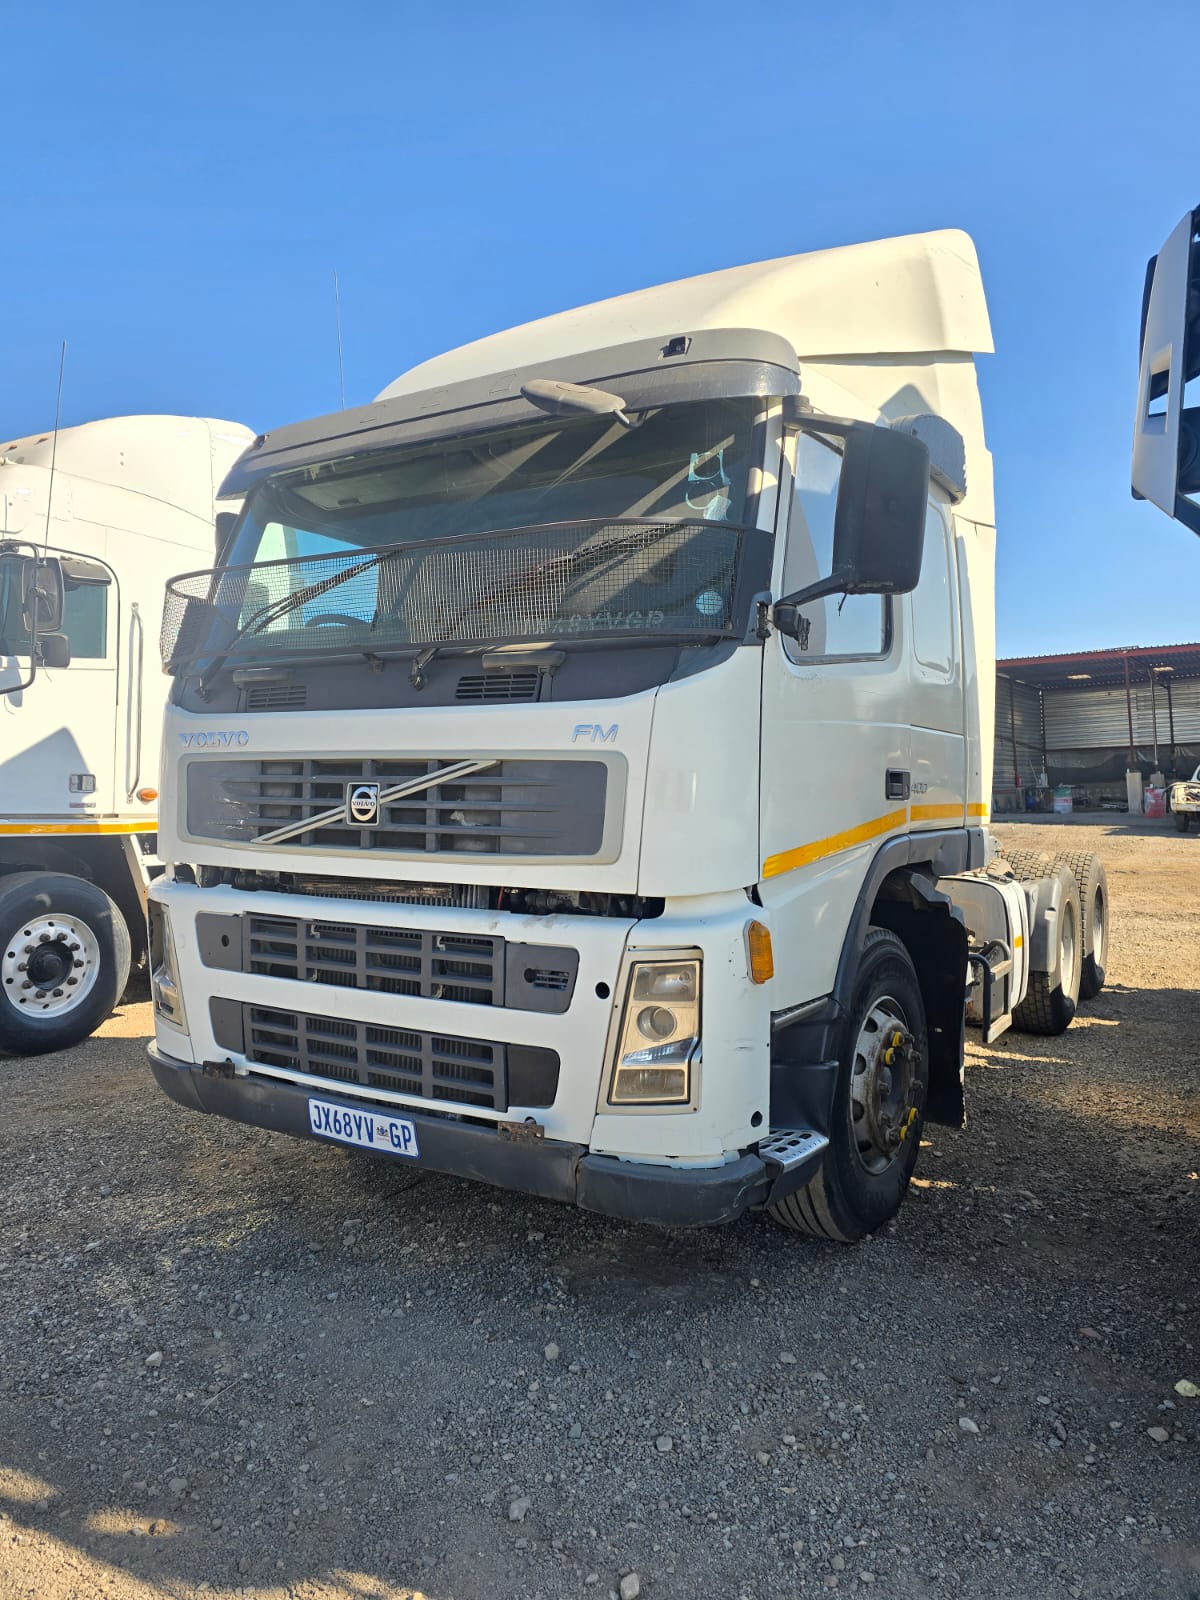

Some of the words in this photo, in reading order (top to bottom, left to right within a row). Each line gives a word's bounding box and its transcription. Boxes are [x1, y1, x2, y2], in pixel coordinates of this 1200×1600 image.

[178, 730, 249, 749] VOLVO
[571, 723, 619, 743] FM
[352, 800, 376, 808] VOLVO
[313, 1104, 374, 1143] JX68YV
[389, 1122, 412, 1151] GP
